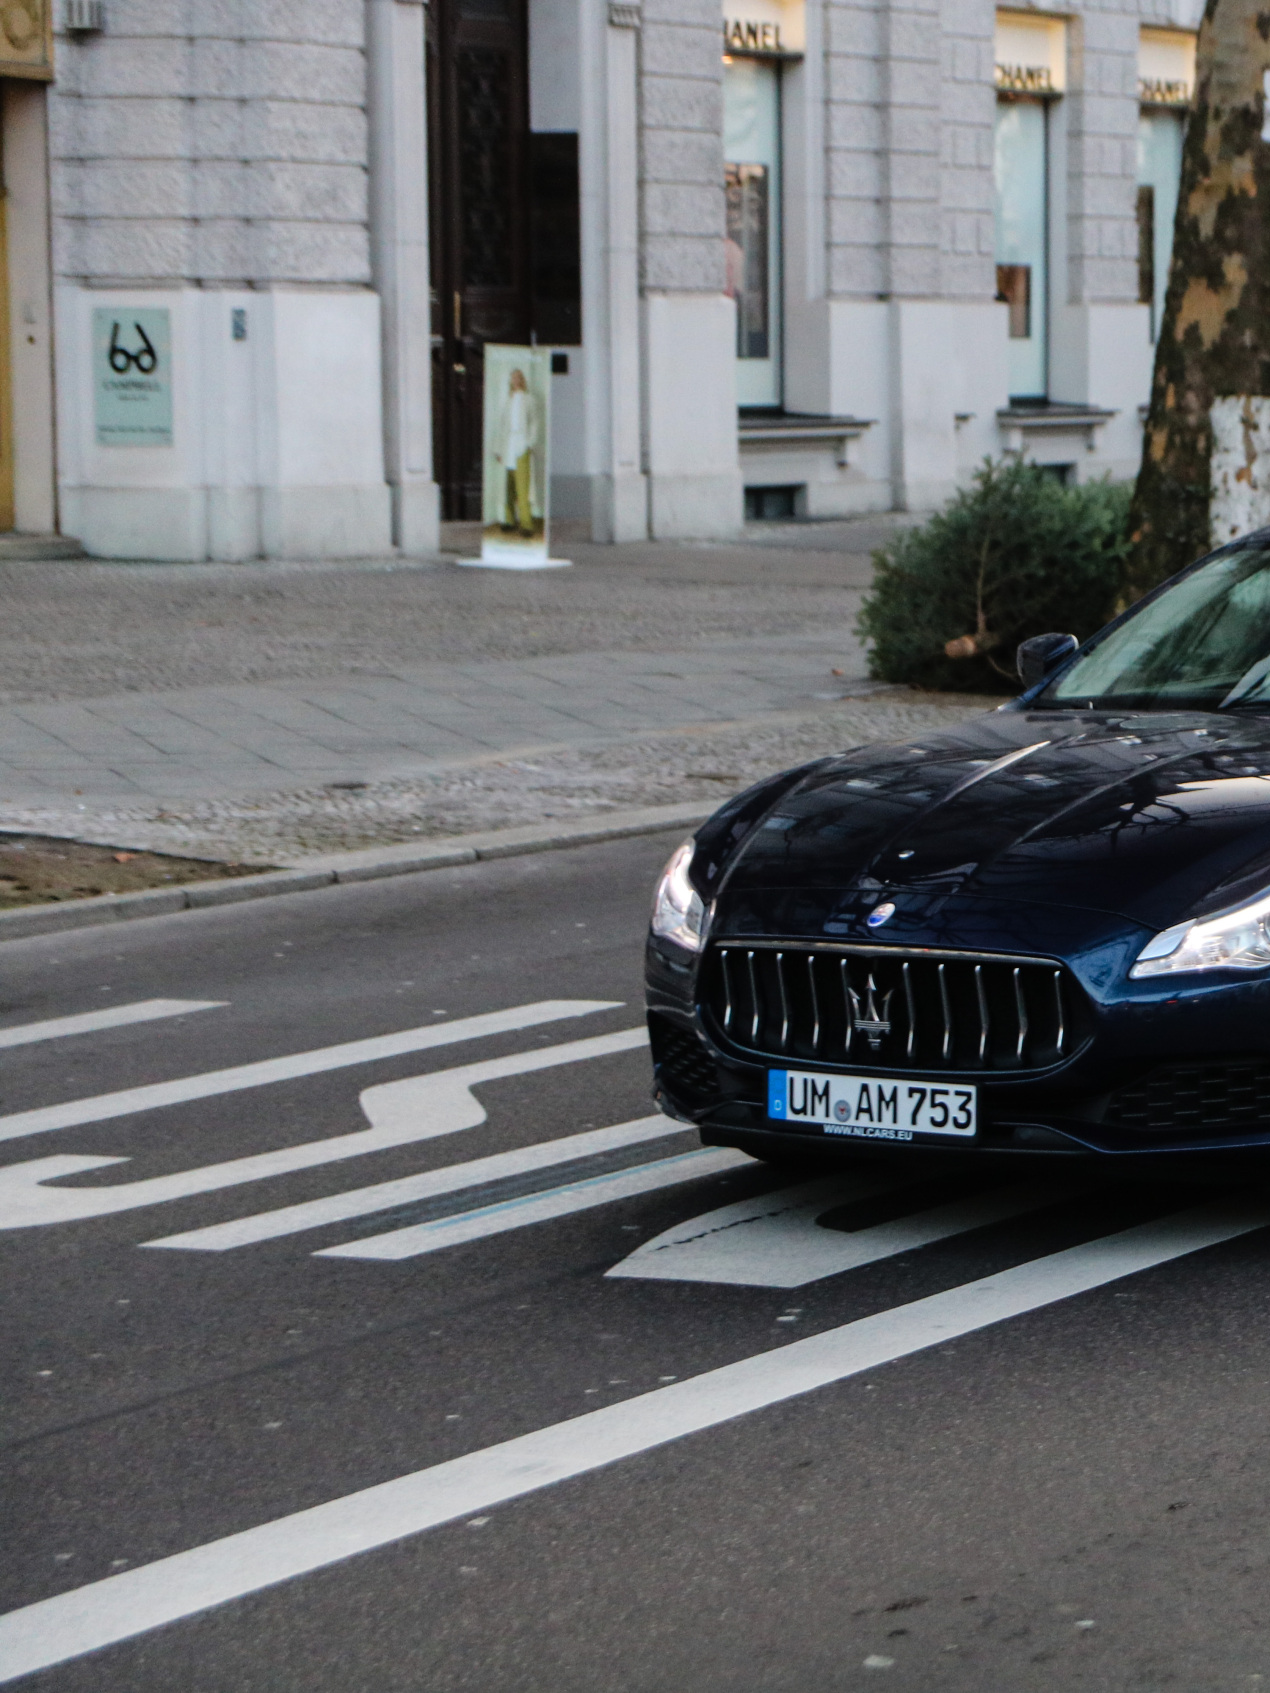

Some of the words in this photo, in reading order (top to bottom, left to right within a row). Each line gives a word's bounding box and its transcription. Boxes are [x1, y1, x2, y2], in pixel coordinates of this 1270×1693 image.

[788, 1076, 830, 1118] UM
[855, 1082, 899, 1124] AM
[907, 1086, 972, 1130] 753
[823, 1123, 913, 1141] WWW.NLCARS.EU
